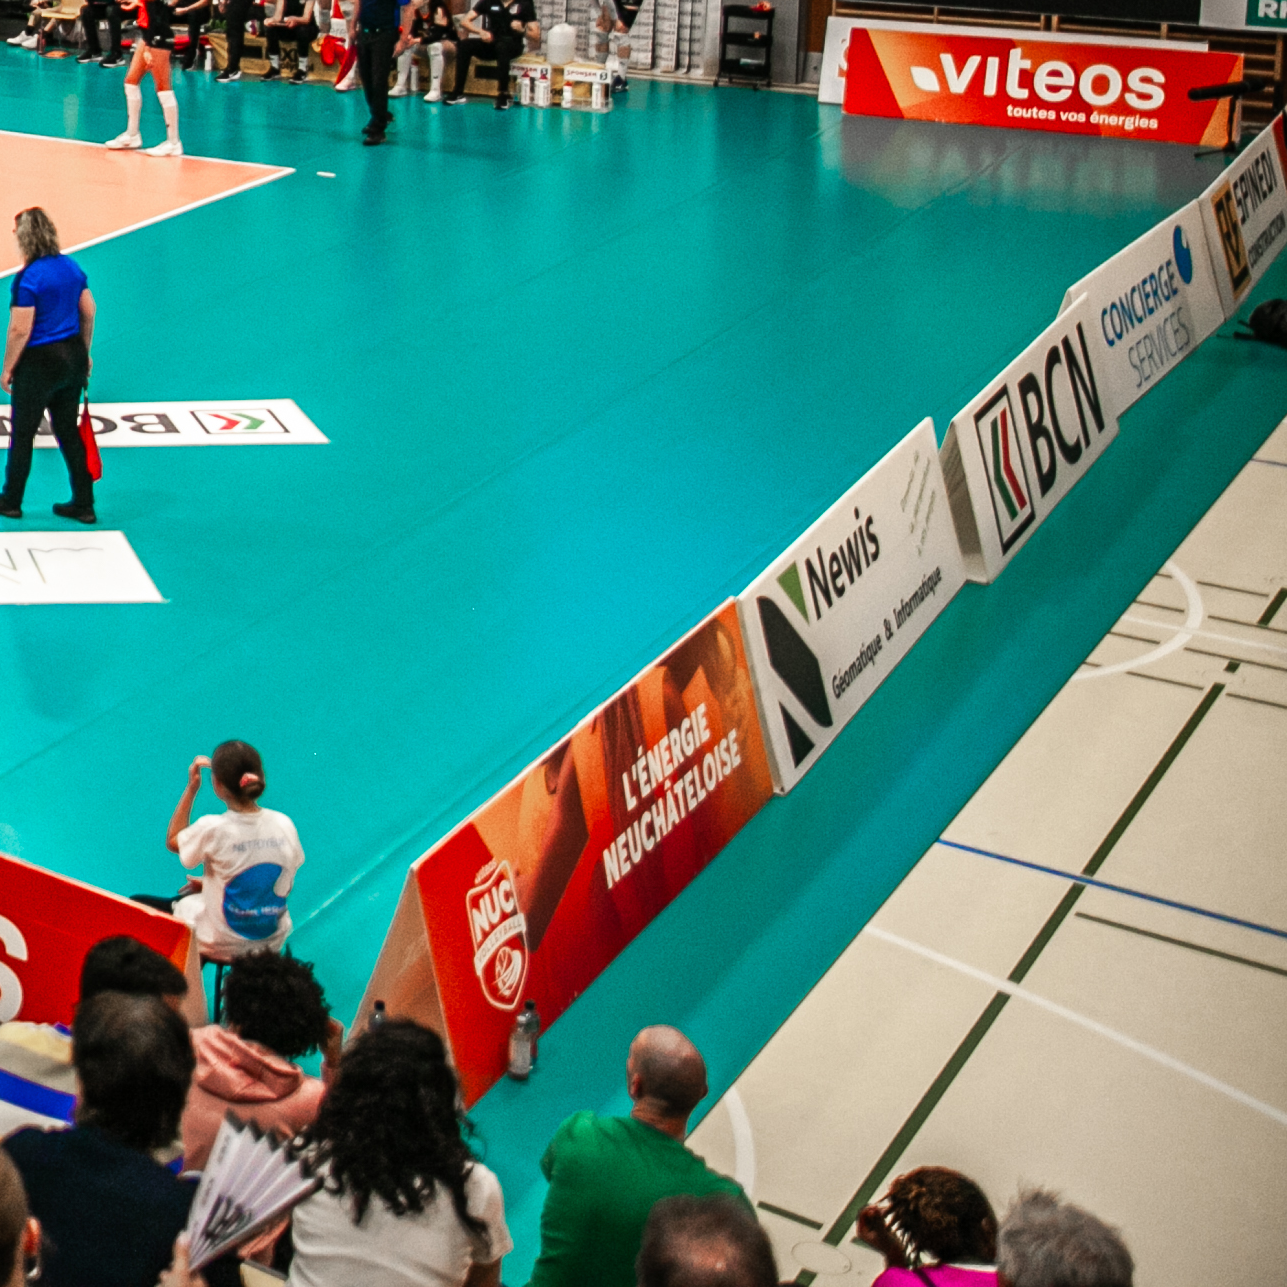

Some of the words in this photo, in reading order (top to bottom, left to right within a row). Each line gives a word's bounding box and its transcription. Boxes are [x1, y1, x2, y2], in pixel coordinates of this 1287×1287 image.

[939, 48, 1165, 110] viteos
[1006, 104, 1056, 121] toutes
[1060, 109, 1086, 122] vos
[1090, 109, 1158, 129] énergies
[1100, 259, 1179, 347] CONCIERGE
[1128, 307, 1191, 388] SERVICES
[1018, 321, 1105, 499] BCN
[805, 505, 880, 621] Newis
[832, 628, 882, 700] Géomatique
[883, 618, 894, 641] &
[892, 566, 942, 629] Informatique
[621, 702, 711, 812] L'ÉNERGIE
[602, 728, 742, 890] NEUCHÂTELOISE
[472, 879, 515, 943] NUC
